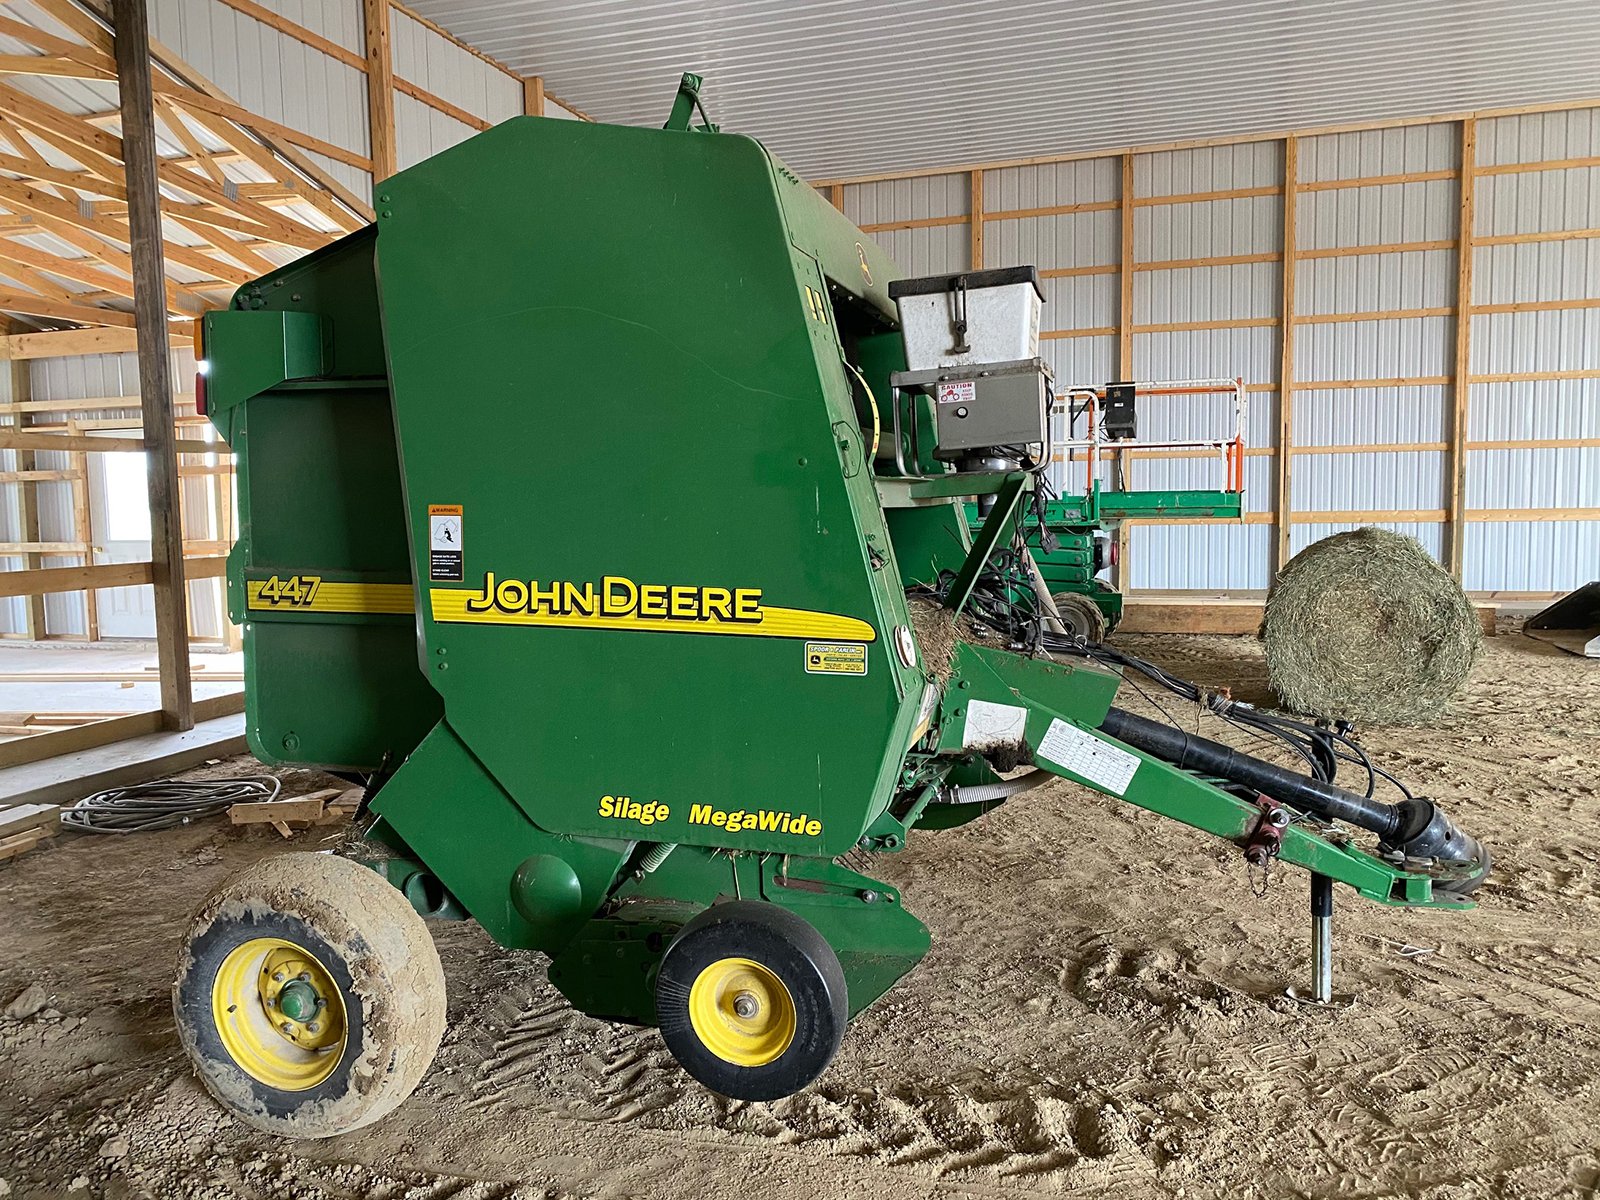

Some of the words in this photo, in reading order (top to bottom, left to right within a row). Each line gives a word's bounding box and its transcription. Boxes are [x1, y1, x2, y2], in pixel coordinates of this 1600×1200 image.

[258, 575, 322, 606] 447
[467, 571, 594, 617] JOHN
[600, 575, 764, 624] DEERE
[598, 795, 670, 825] Silage
[688, 803, 823, 836] MegaWide
